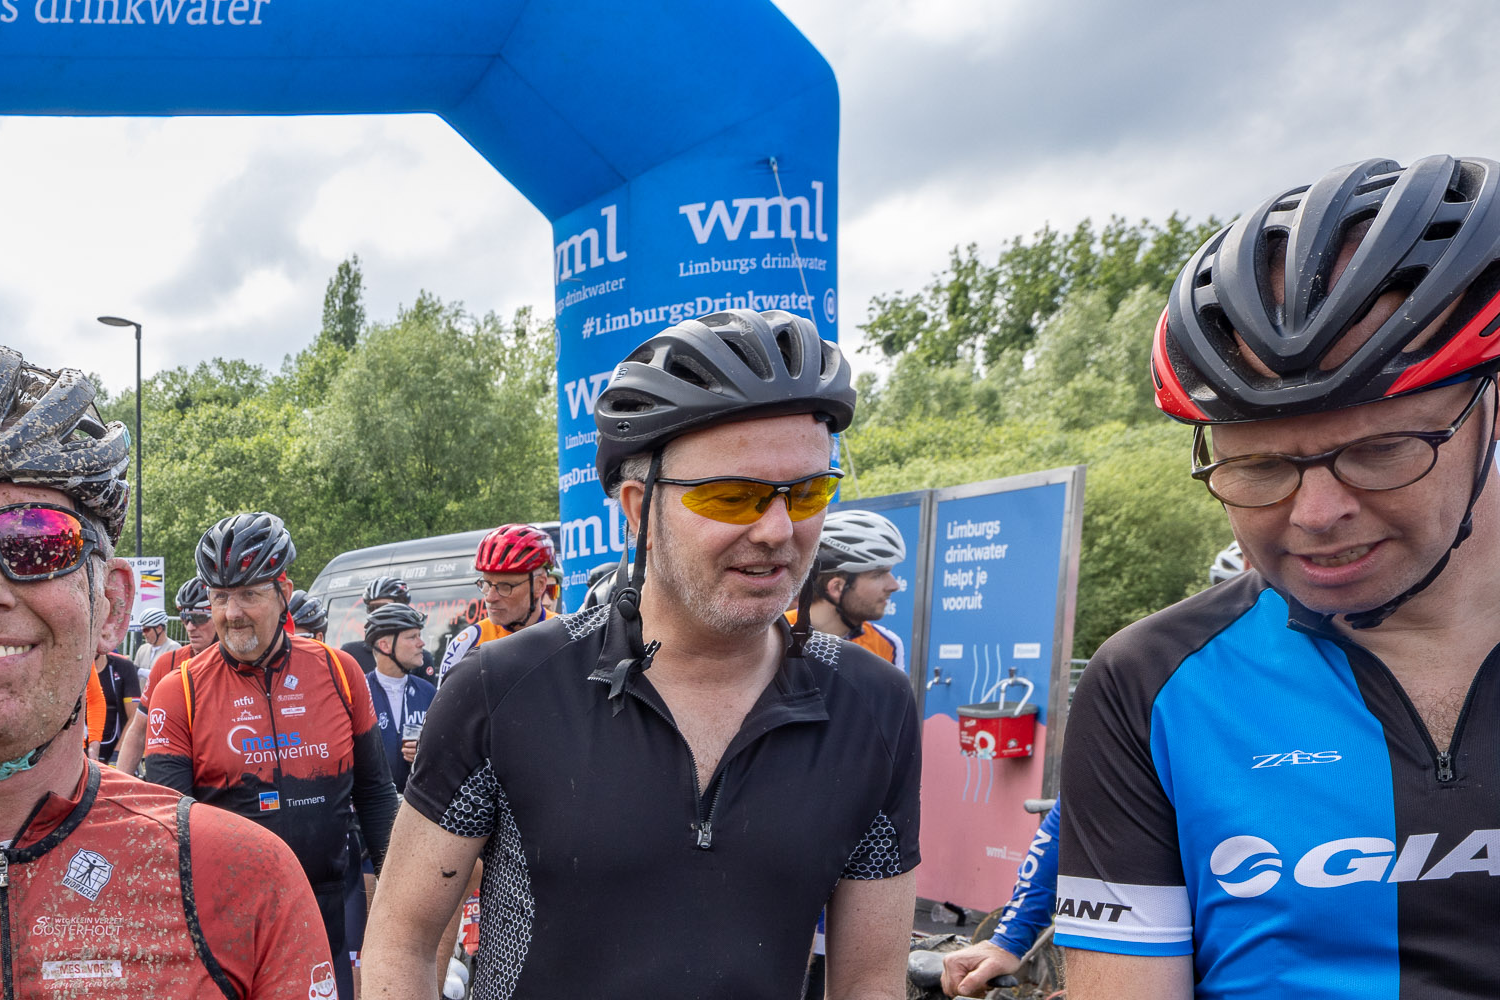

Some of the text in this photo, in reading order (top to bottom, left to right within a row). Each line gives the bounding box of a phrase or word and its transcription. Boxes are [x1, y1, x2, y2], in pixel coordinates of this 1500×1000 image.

[34, 0, 270, 26] drinkwater
[679, 181, 828, 244] wml
[679, 253, 827, 277] Limburgs drinkwater
[565, 277, 626, 307] drinkwater
[582, 290, 815, 339] #LimburgsDrinkwater
[946, 519, 1001, 540] Limburgs
[945, 543, 1008, 563] drinkwater
[943, 566, 988, 590] helpt je
[942, 591, 983, 611] vooruit
[234, 695, 254, 707] ntfu
[242, 731, 301, 752] maas
[244, 742, 330, 765] zonwering
[286, 795, 325, 807] Timmers
[1055, 897, 1132, 923] IANT
